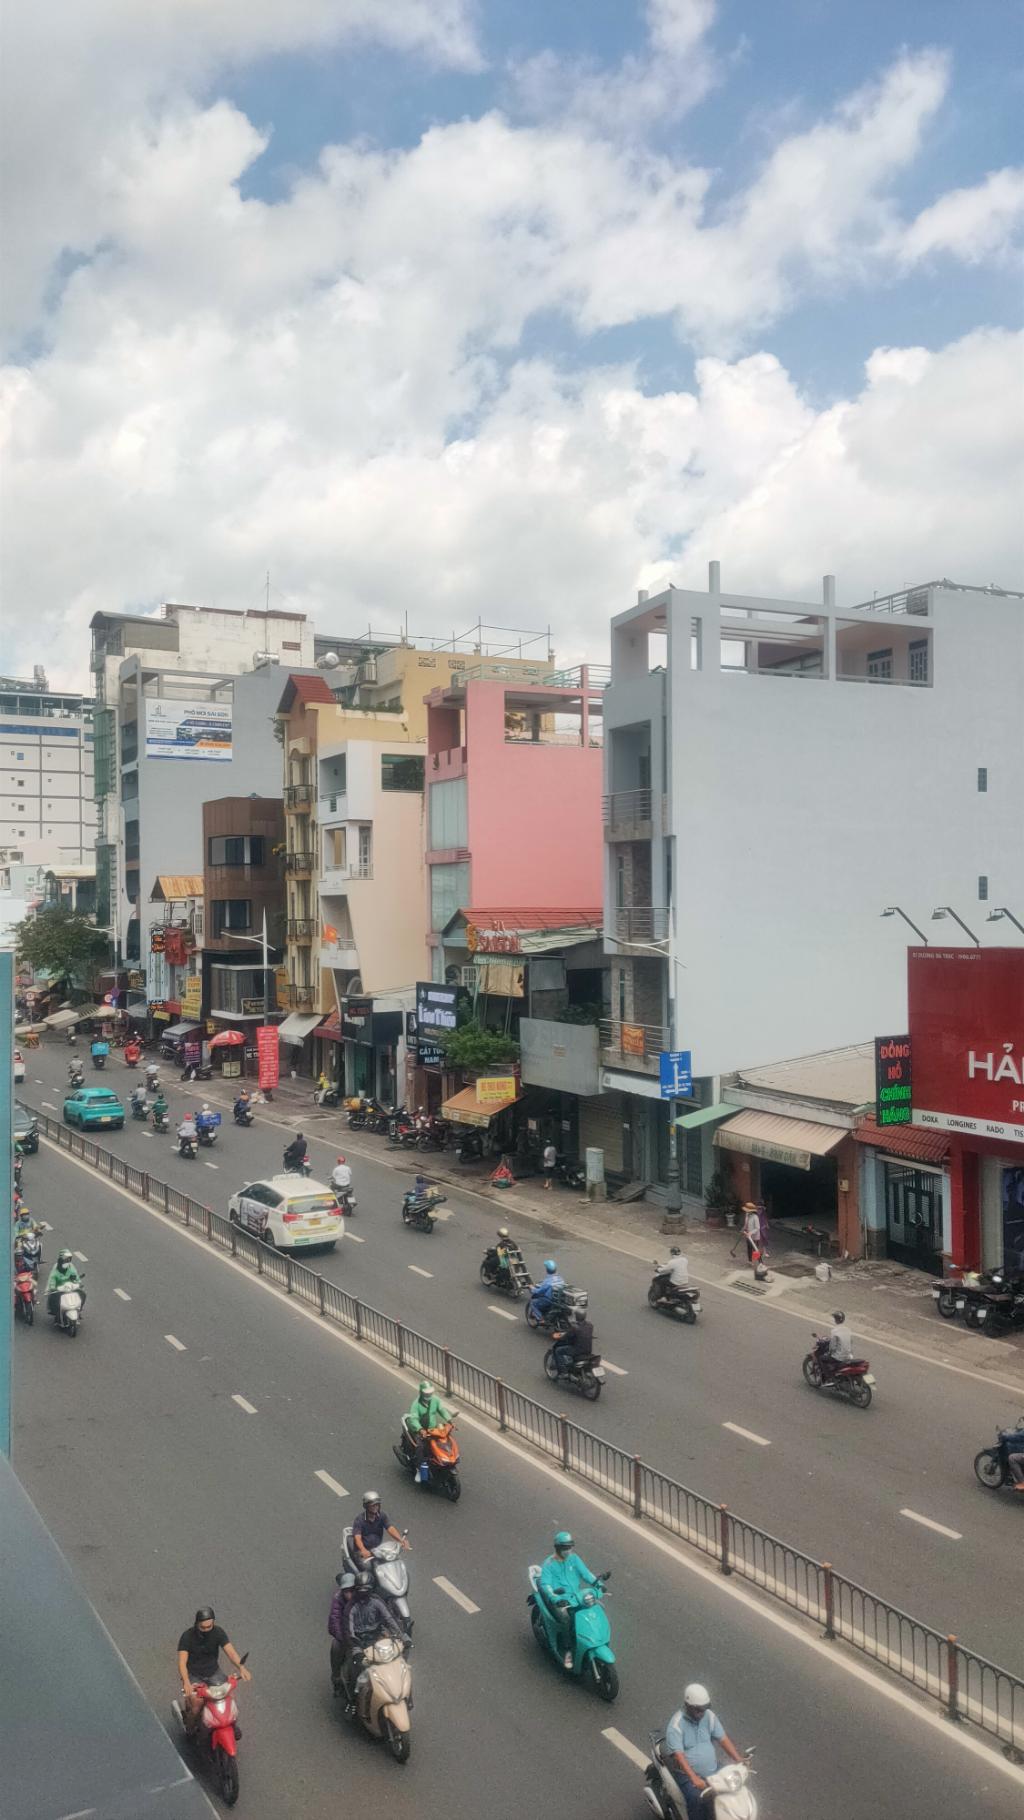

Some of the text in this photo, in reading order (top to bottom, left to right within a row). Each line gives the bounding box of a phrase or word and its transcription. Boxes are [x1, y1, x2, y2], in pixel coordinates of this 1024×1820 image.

[880, 1040, 910, 1059] ĐỒNG
[887, 1061, 902, 1080] HỒ
[922, 1114, 940, 1123] DOXA
[947, 1118, 977, 1130] LONGINES
[986, 1125, 1004, 1134] RADO
